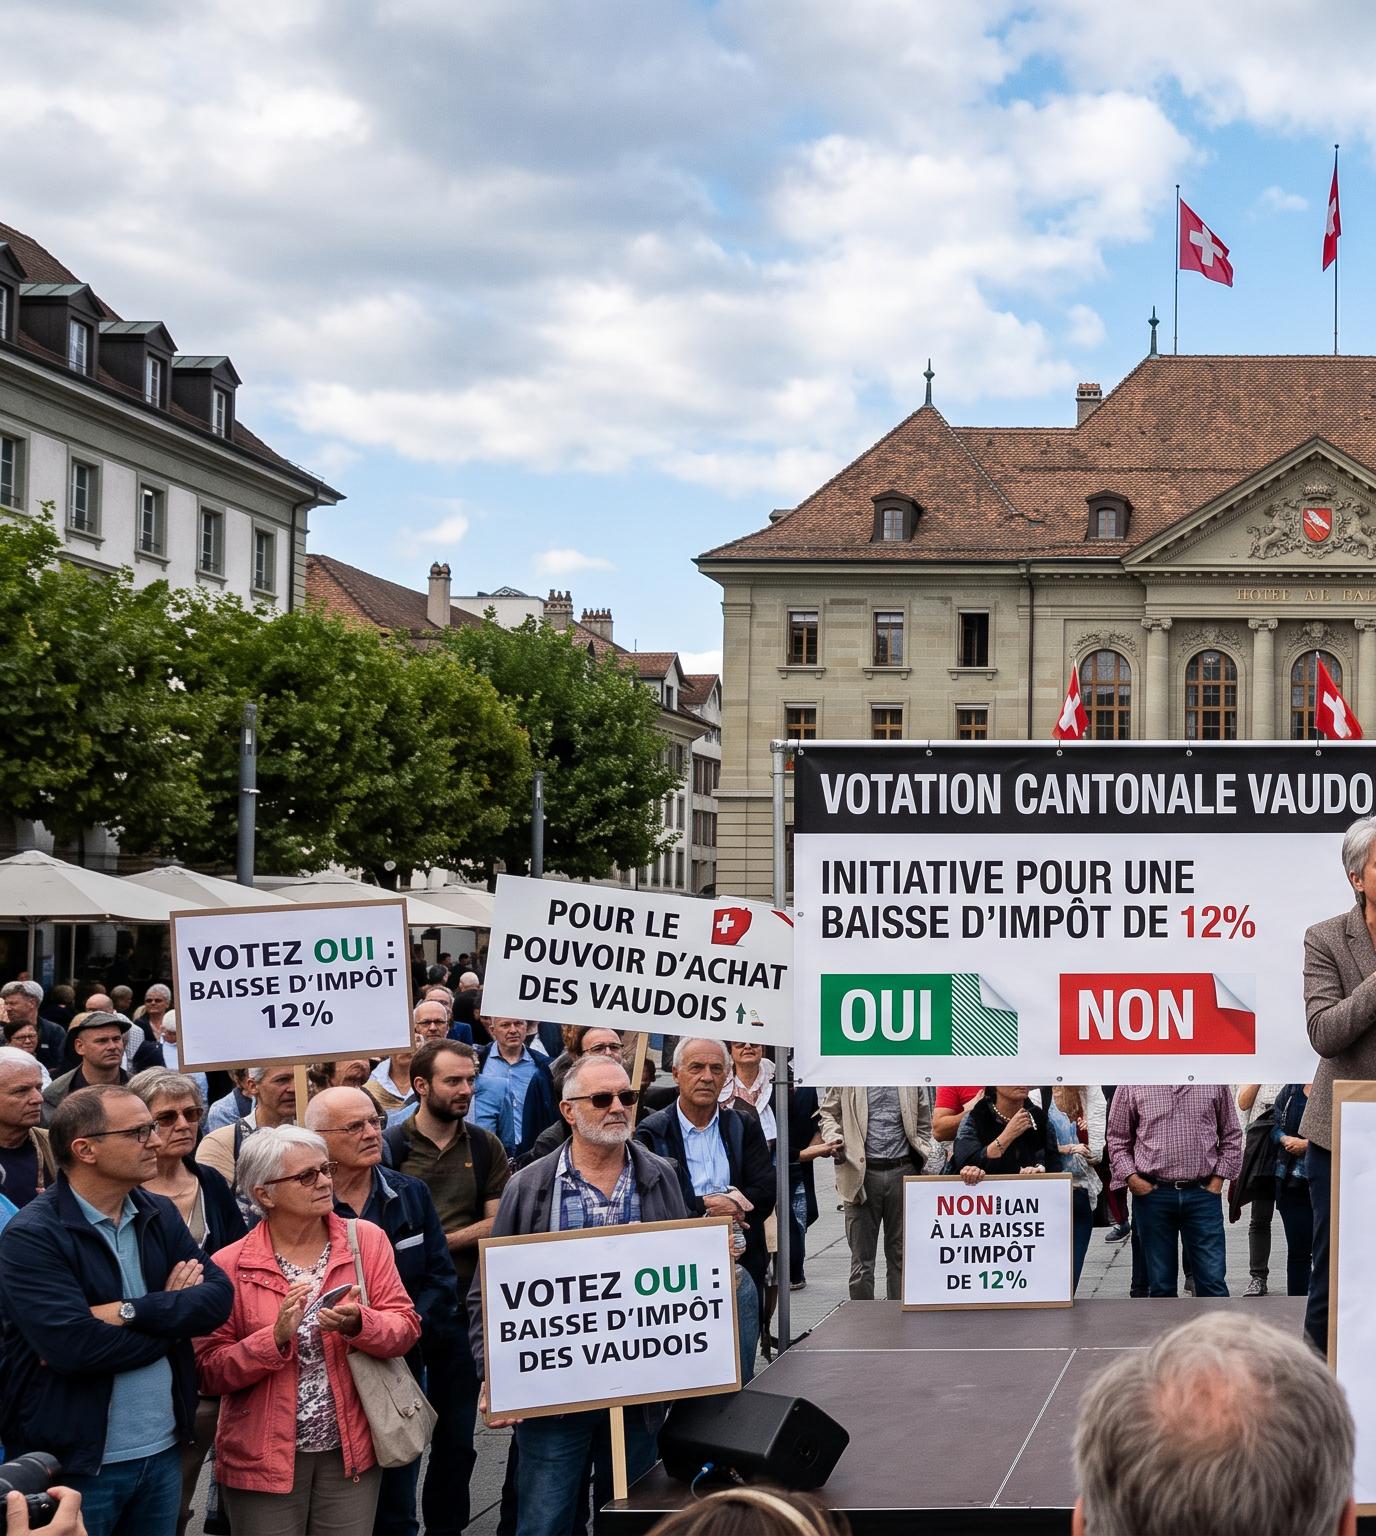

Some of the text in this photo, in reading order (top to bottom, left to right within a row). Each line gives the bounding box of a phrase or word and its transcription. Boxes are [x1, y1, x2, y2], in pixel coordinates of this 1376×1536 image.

[820, 773, 1000, 814] VOTATION
[1015, 773, 1236, 814] CANTONALE
[823, 860, 1194, 894] INITIATIVE POUR UNE
[548, 900, 679, 939] POUR LE
[822, 897, 1255, 939] BAISSE D'IMPÔT DE 12%
[188, 941, 302, 971] VOTEZ
[314, 937, 373, 963] OUI
[504, 934, 787, 989] POUVOIR D'ACHAT
[190, 966, 398, 1000] BAISSE D'IMPÔT
[519, 975, 726, 1022] DES VAUDOIS
[261, 1000, 333, 1028] 12%
[841, 989, 931, 1041] OUI
[1079, 989, 1193, 1040] NON
[938, 1195, 993, 1215] NON
[931, 1219, 1044, 1239] À LA BAISSE
[940, 1241, 1035, 1264] D'IMPÔT
[500, 1272, 621, 1310] VOTEZ
[635, 1264, 697, 1296] OUI
[948, 1270, 1027, 1289] DE 12%
[501, 1296, 723, 1342] BAISSE D'IMPÔT
[520, 1332, 708, 1372] DES VAUDOIS
